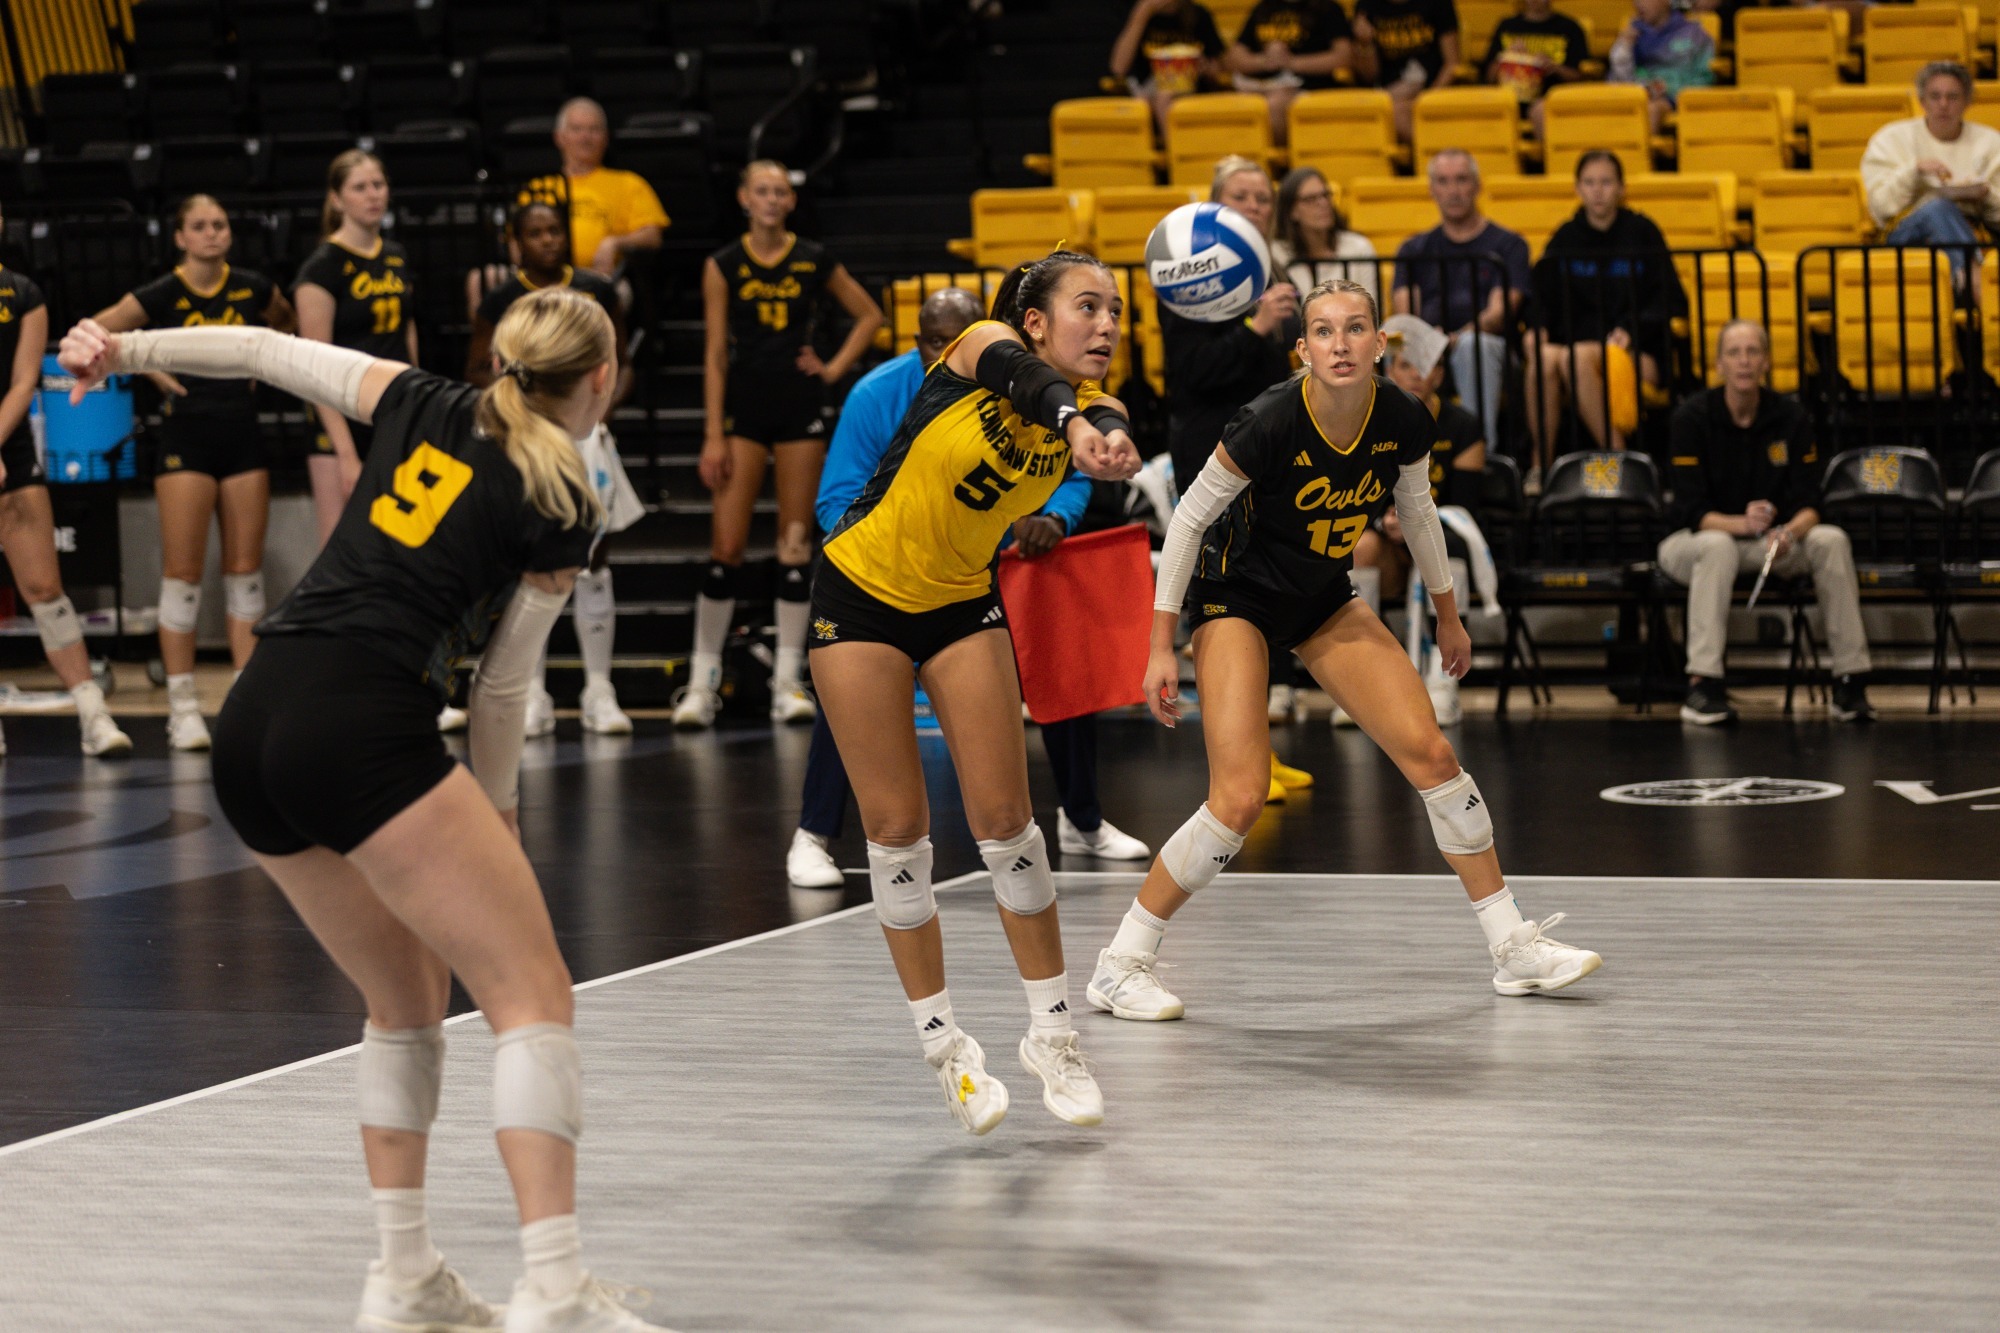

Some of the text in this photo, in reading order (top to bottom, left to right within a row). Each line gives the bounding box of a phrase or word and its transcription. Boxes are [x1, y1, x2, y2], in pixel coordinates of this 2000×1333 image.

[350, 269, 405, 300] Owls
[1157, 254, 1220, 284] molten
[368, 440, 474, 548] 9
[954, 457, 1018, 512] 5
[1295, 469, 1387, 511] Owls
[1306, 513, 1369, 559] 13
